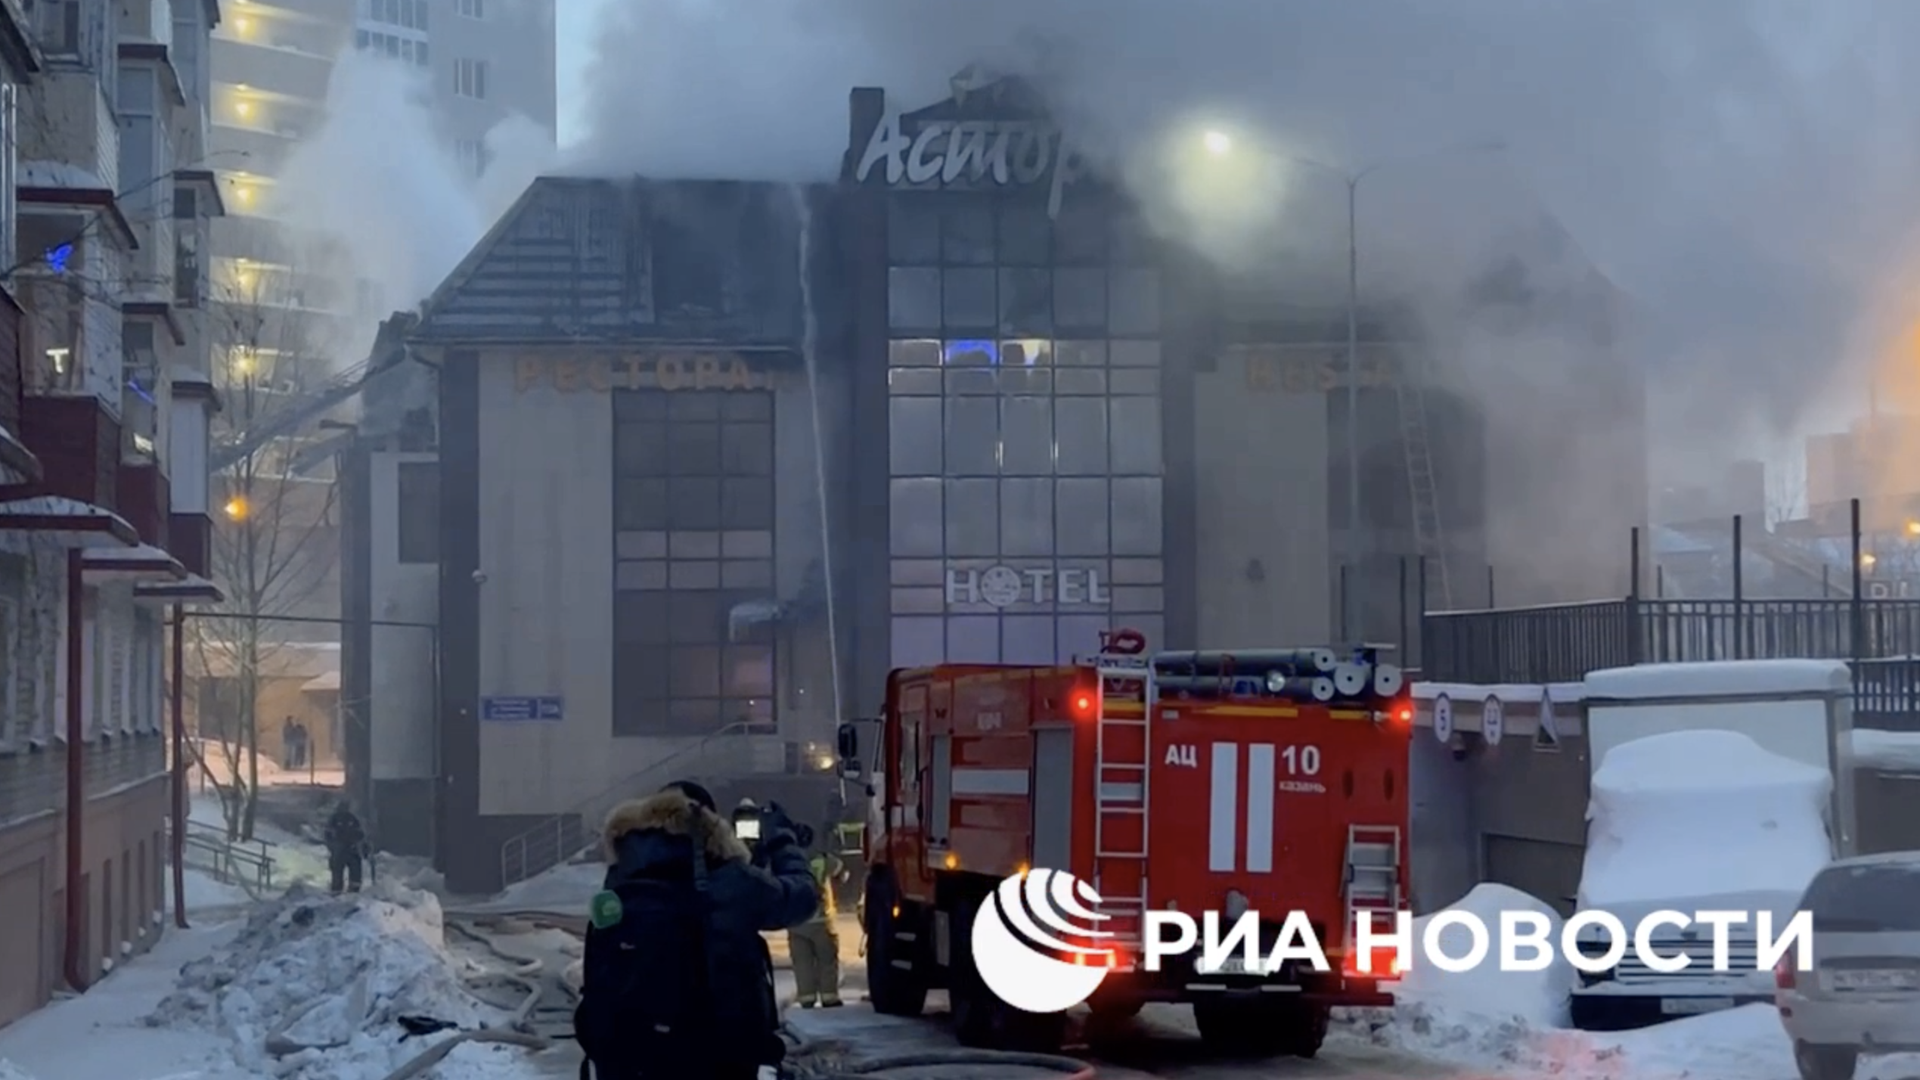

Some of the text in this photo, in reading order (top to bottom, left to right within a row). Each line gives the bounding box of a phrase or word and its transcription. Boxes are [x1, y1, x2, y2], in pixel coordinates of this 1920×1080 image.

[946, 566, 1111, 607] HOTEL
[1165, 744, 1198, 768] АЦ
[1282, 745, 1320, 775] 10
